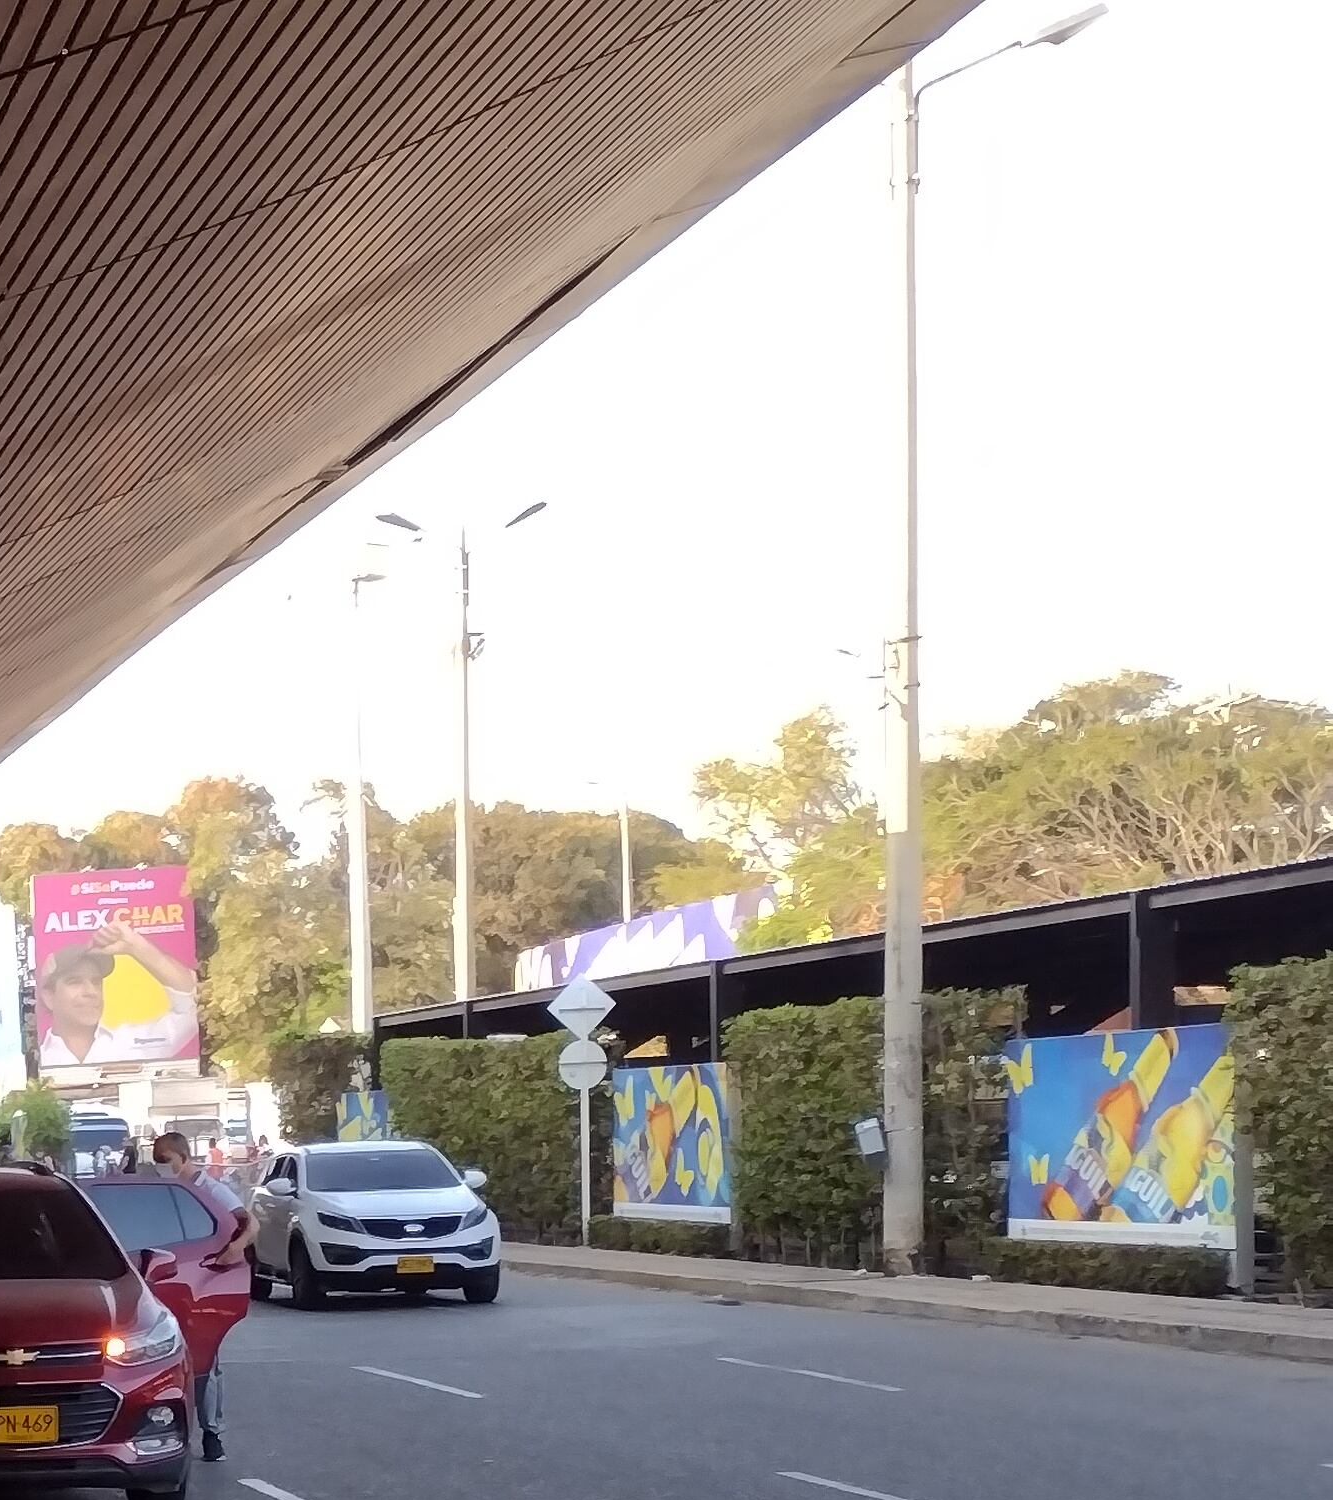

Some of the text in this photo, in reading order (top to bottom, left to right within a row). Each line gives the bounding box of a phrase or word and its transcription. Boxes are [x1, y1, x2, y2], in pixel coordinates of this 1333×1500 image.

[44, 908, 110, 933] ALEX
[113, 903, 183, 926] CHAR
[21, 1414, 53, 1433] 469
